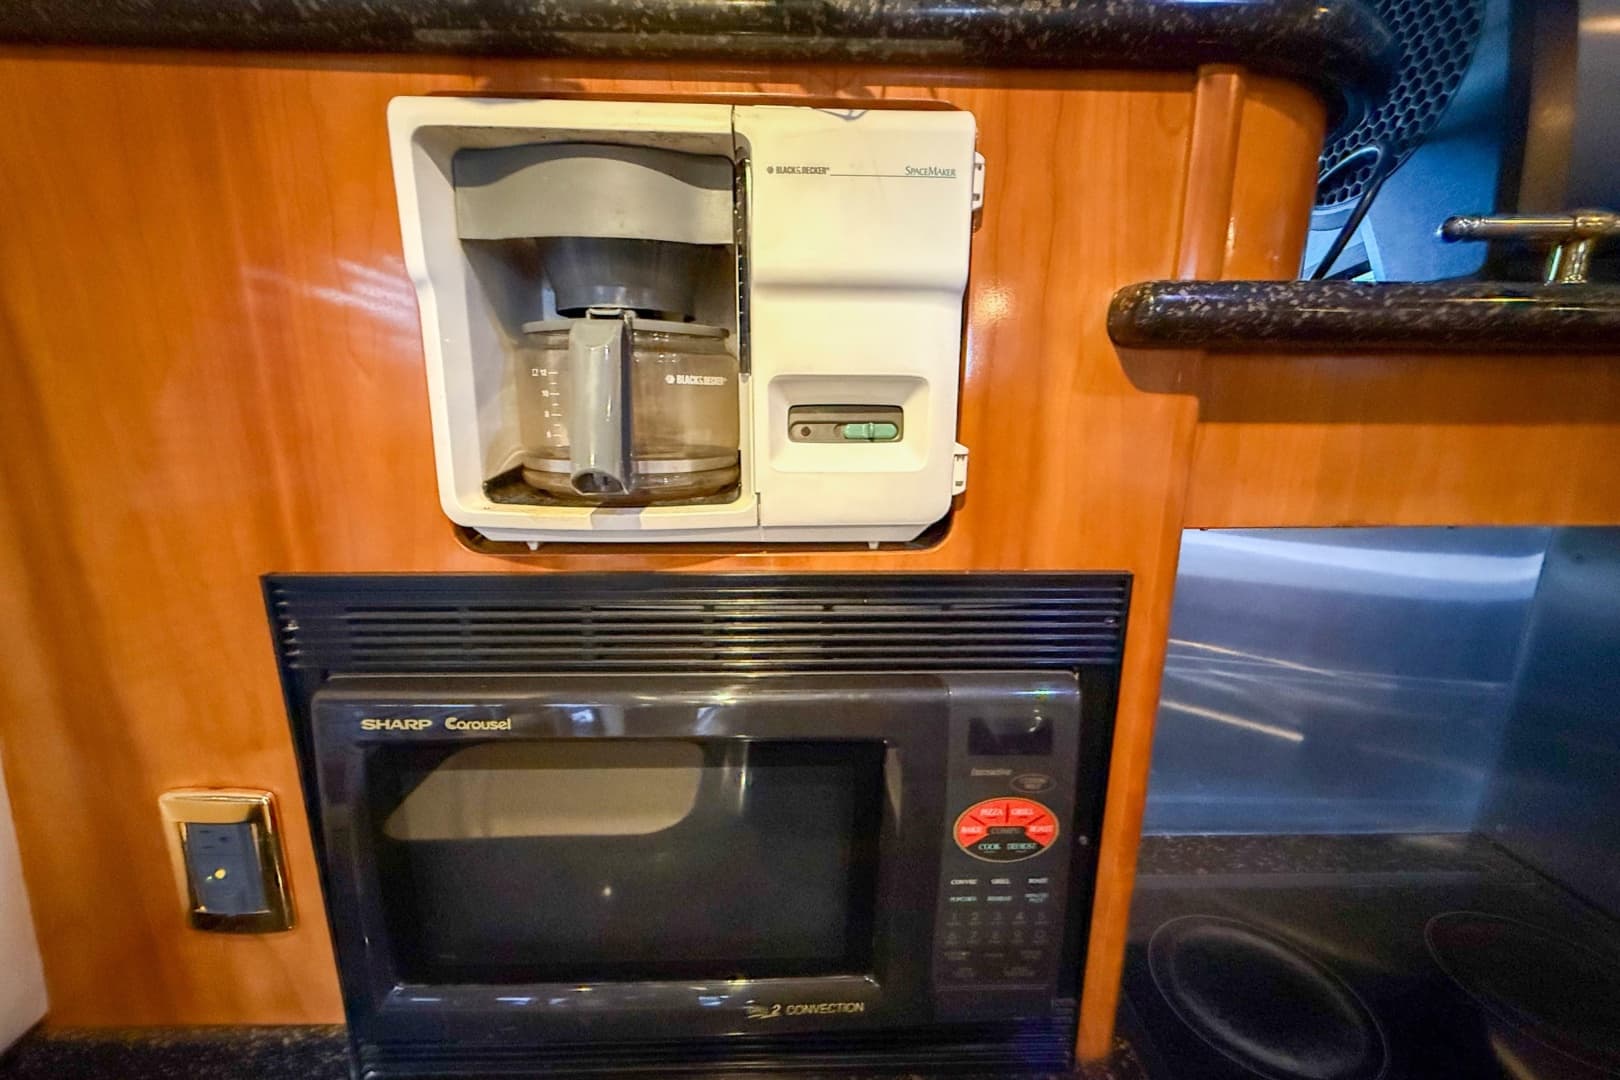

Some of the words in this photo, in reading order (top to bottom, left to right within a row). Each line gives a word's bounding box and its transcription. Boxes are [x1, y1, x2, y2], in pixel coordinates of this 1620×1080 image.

[360, 718, 433, 731] SHARP
[444, 716, 512, 731] Carousel
[785, 1001, 865, 1016] CONVECTION
